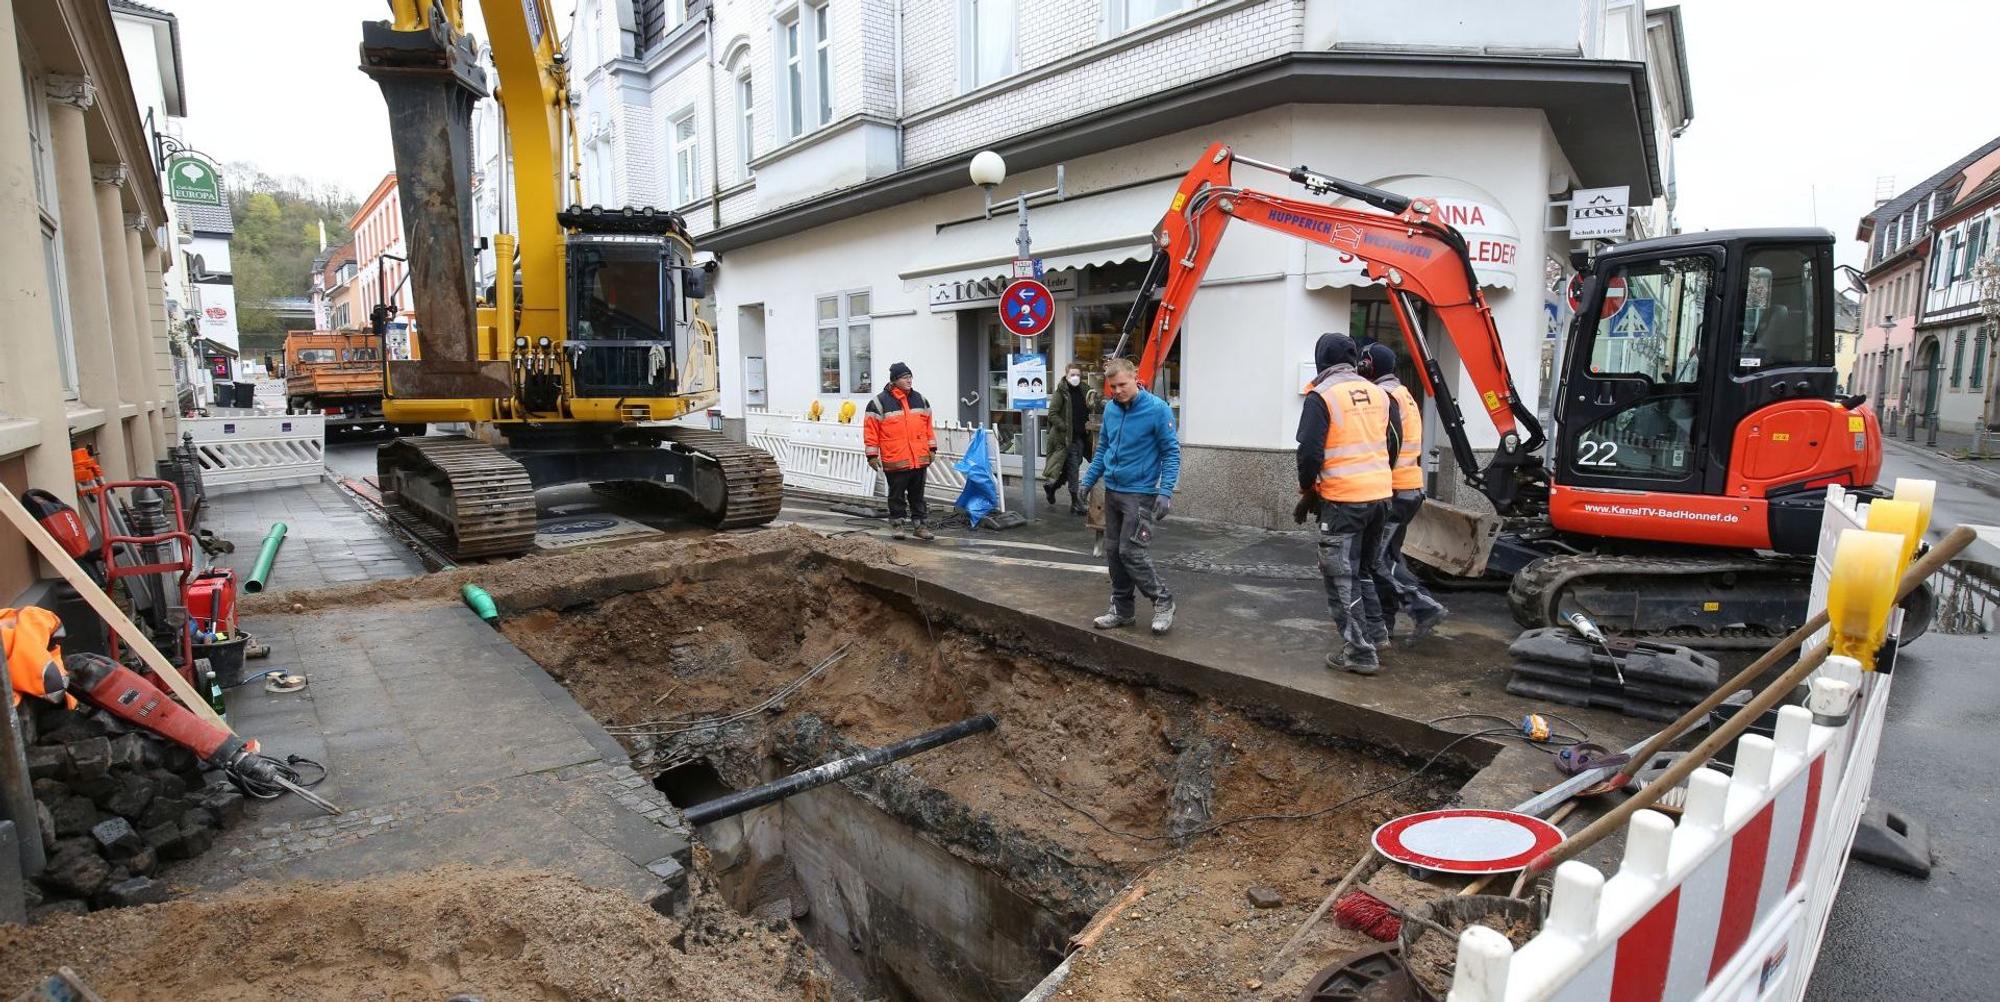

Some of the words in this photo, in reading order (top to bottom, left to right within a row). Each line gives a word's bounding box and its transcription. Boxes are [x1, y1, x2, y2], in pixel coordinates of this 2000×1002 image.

[175, 189, 215, 200] EUROPA
[1268, 209, 1332, 234] HUPPERICH
[1438, 205, 1485, 225] NNA
[1466, 241, 1516, 264] LEDER
[1578, 441, 1618, 466] 22
[1584, 503, 1739, 523] www.KanalTV-BadHonnef.de
